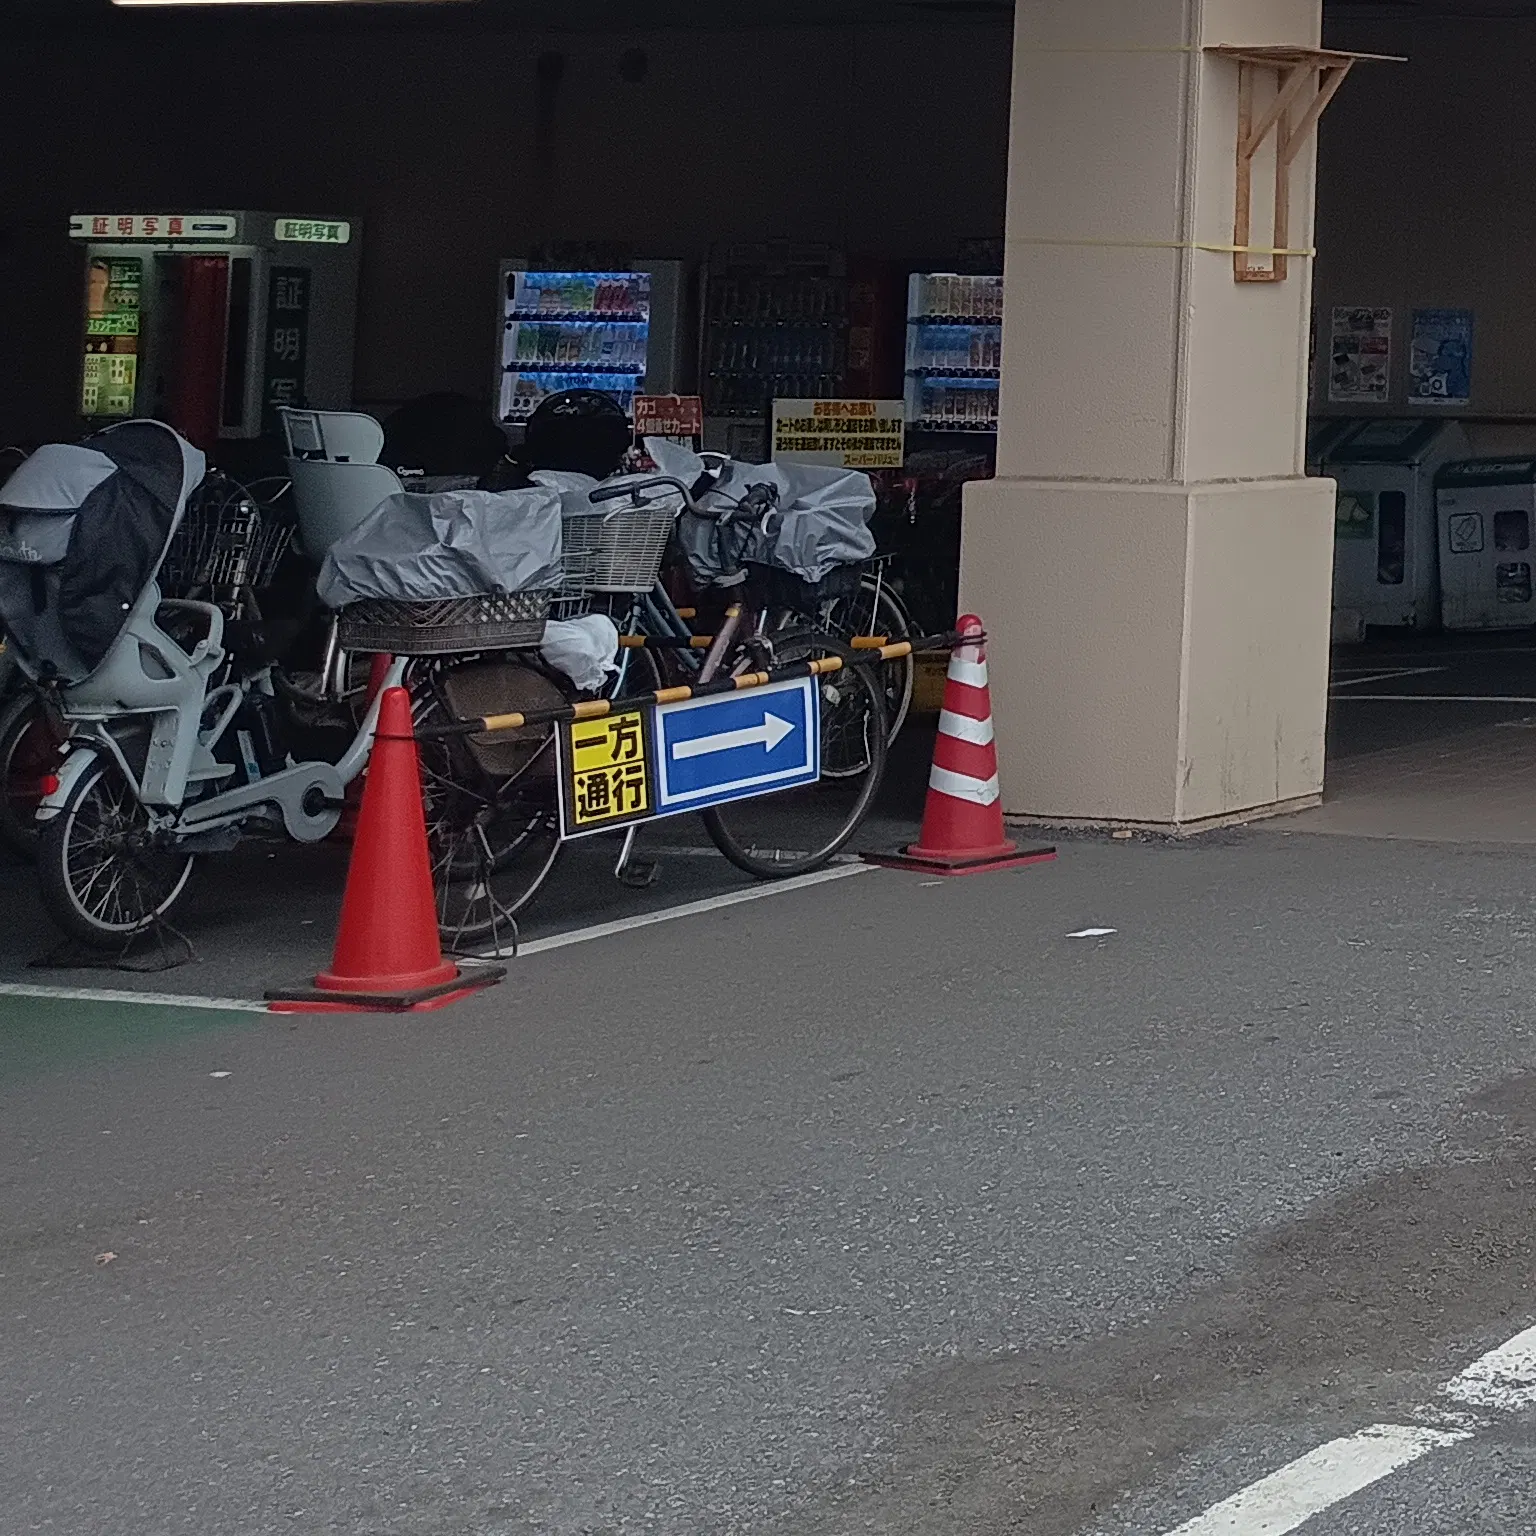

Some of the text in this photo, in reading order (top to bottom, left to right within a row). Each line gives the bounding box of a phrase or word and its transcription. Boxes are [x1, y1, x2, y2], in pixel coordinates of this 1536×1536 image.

[91, 216, 185, 236] 証明写真
[283, 221, 341, 241] 証明写真
[575, 716, 640, 761] 一方
[577, 765, 643, 820] 通行
